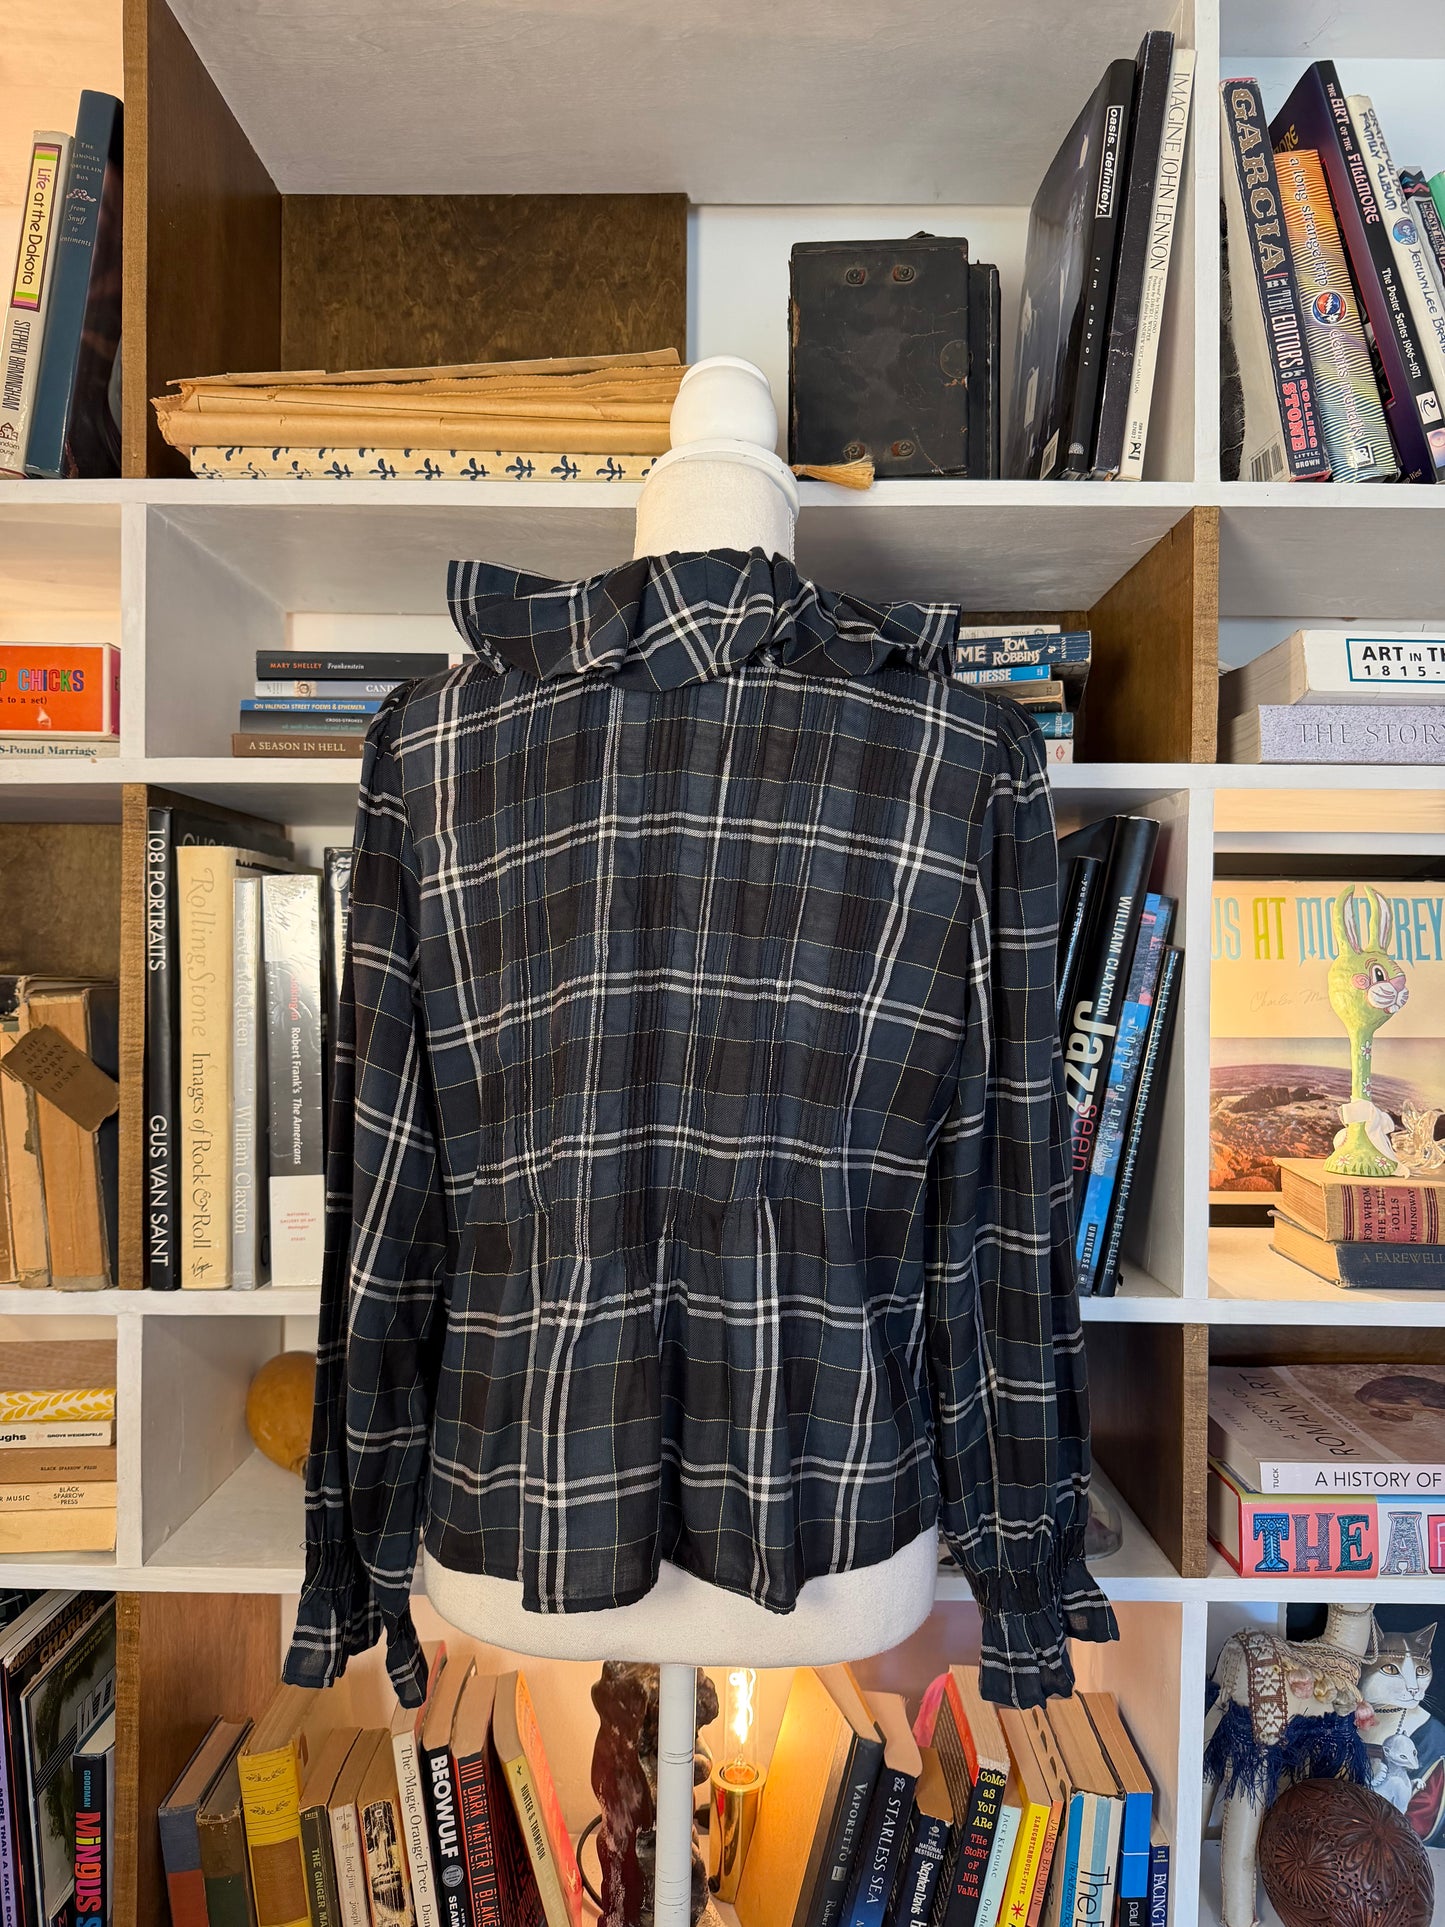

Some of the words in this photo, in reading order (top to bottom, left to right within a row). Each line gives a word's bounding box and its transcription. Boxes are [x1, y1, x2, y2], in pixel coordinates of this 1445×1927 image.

[1326, 83, 1337, 98] THE
[1107, 108, 1119, 147] oasis.
[1163, 72, 1191, 153] IMAGINE
[1331, 98, 1350, 126] ART
[1339, 127, 1349, 137] OF
[1342, 136, 1353, 151] THE
[36, 167, 52, 190] Life
[1159, 155, 1180, 200] JOHN
[1289, 157, 1299, 166] a
[1359, 112, 1383, 160] FAMILY
[1377, 163, 1397, 211] ALBUM
[1099, 151, 1115, 214] definitely.
[1231, 88, 1286, 275] GARCIA
[1293, 169, 1309, 202] long
[1347, 152, 1380, 225] FILLMORE
[33, 192, 45, 207] at
[30, 209, 46, 232] the
[1149, 204, 1174, 271] LENNON
[1301, 204, 1322, 258] strange
[22, 234, 43, 285] Dakota
[1314, 258, 1329, 287] trip
[1382, 268, 1392, 285] The
[1266, 290, 1295, 313] THE
[1386, 285, 1400, 312] Poster
[10, 319, 31, 356] STEPHEN
[1271, 313, 1305, 369] EDITORS
[1395, 312, 1408, 339] Series
[1330, 328, 1349, 379] dennis
[2, 355, 26, 411] BIRMINGHAM
[1281, 381, 1307, 452] STONE
[1300, 379, 1318, 449] ROLLING
[1295, 458, 1321, 469] BROWN
[992, 650, 1041, 666] ROBBINS
[1002, 637, 1029, 652] TOM
[1362, 646, 1404, 662] ART
[1409, 652, 1422, 662] IN
[18, 668, 84, 692] CHICKS
[327, 662, 365, 670] Frankenstein
[979, 668, 1011, 682] HESSE
[7, 696, 17, 704] to
[30, 696, 48, 704] set)
[48, 746, 97, 756] Marriage
[250, 742, 257, 750] A
[259, 742, 300, 751] SEASON
[303, 743, 316, 751] IN
[318, 743, 346, 752] HELL
[1296, 723, 1353, 745] THE
[148, 828, 166, 864] 108
[148, 869, 167, 972] PORTRAITS
[186, 867, 216, 967] Rolling
[1109, 896, 1132, 954] WILLIAM
[1252, 897, 1286, 960] AT
[188, 965, 216, 1038] Stone
[1096, 957, 1120, 1017] CLAXTON
[1156, 971, 1172, 1014] SALLY
[291, 1027, 301, 1057] Robert
[1120, 1025, 1140, 1070] TODD
[1148, 1018, 1163, 1060] MANN
[27, 1044, 61, 1076] KNOWN
[35, 1050, 69, 1081] WORKS
[292, 1059, 301, 1094] Frank's
[187, 1052, 211, 1114] Images
[292, 1098, 301, 1114] The
[1102, 1083, 1127, 1159] OLDHAM
[1129, 1065, 1154, 1143] IMMEDIATE
[150, 1114, 167, 1159] GUS
[189, 1118, 213, 1136] of
[236, 1105, 251, 1168] William
[292, 1114, 302, 1165] Americans
[1072, 1102, 1099, 1171] seen
[192, 1139, 212, 1185] Rock
[1119, 1148, 1138, 1199] FAMILY
[151, 1163, 168, 1208] VAN
[235, 1171, 251, 1234] Claxton
[1376, 1187, 1386, 1215] BELL
[1362, 1187, 1373, 1222] WHOM
[1391, 1198, 1400, 1232] TOLLS
[1408, 1189, 1418, 1242] HEMINGWAY
[151, 1212, 168, 1267] SANT
[192, 1213, 212, 1249] Roll
[1081, 1225, 1097, 1269] UNIVERSE
[1104, 1203, 1126, 1276] APERTURE
[1363, 1223, 1374, 1241] FOR
[1376, 1218, 1387, 1241] THE
[1362, 1253, 1371, 1263] A
[1238, 1373, 1287, 1400] ART
[1272, 1402, 1361, 1456] ROMAN
[1272, 1468, 1280, 1488] TUCK
[1314, 1471, 1329, 1487] A
[1334, 1472, 1410, 1488] HISTORY
[1416, 1472, 1442, 1488] OF
[6, 1494, 31, 1502] MUSIC
[1252, 1512, 1374, 1573] THE
[39, 1601, 96, 1665] CHARLES
[9, 1643, 38, 1673] MORE
[401, 1745, 413, 1771] The
[83, 1770, 91, 1808] GOODMAN
[404, 1767, 420, 1813] Magic
[430, 1754, 459, 1859] BEOWULF
[465, 1784, 488, 1819] DARK
[410, 1814, 424, 1860] Orange
[520, 1783, 534, 1814] HUNTER
[530, 1820, 546, 1861] THOMPSON
[838, 1782, 869, 1862] VAPORETTO
[873, 1797, 901, 1872] STARLESS
[1000, 1813, 1011, 1835] JACK
[1045, 1819, 1059, 1854] JAMES
[312, 1847, 321, 1868] THE
[470, 1821, 494, 1870] MATTER
[914, 1848, 944, 1861] BESTSELLER
[918, 1842, 942, 1855] NATIONAL
[927, 1838, 938, 1847] THE
[991, 1836, 1006, 1878] KEROUAC
[1019, 1815, 1042, 1895] SLAUGHTERHOUSE-FIVE
[345, 1856, 355, 1873] lord
[416, 1860, 428, 1893] Tree
[915, 1860, 934, 1893] Stephen
[1034, 1858, 1051, 1906] BALDWIN
[3, 1873, 11, 1901] FAKE
[314, 1871, 326, 1908] GINGER
[866, 1875, 885, 1904] SEA
[911, 1890, 927, 1915] Davis
[983, 1898, 992, 1911] On
[1077, 1866, 1112, 1915] The
[1152, 1873, 1167, 1918] FACING
[349, 1901, 361, 1925] joseph
[1128, 1901, 1140, 1927] paul
